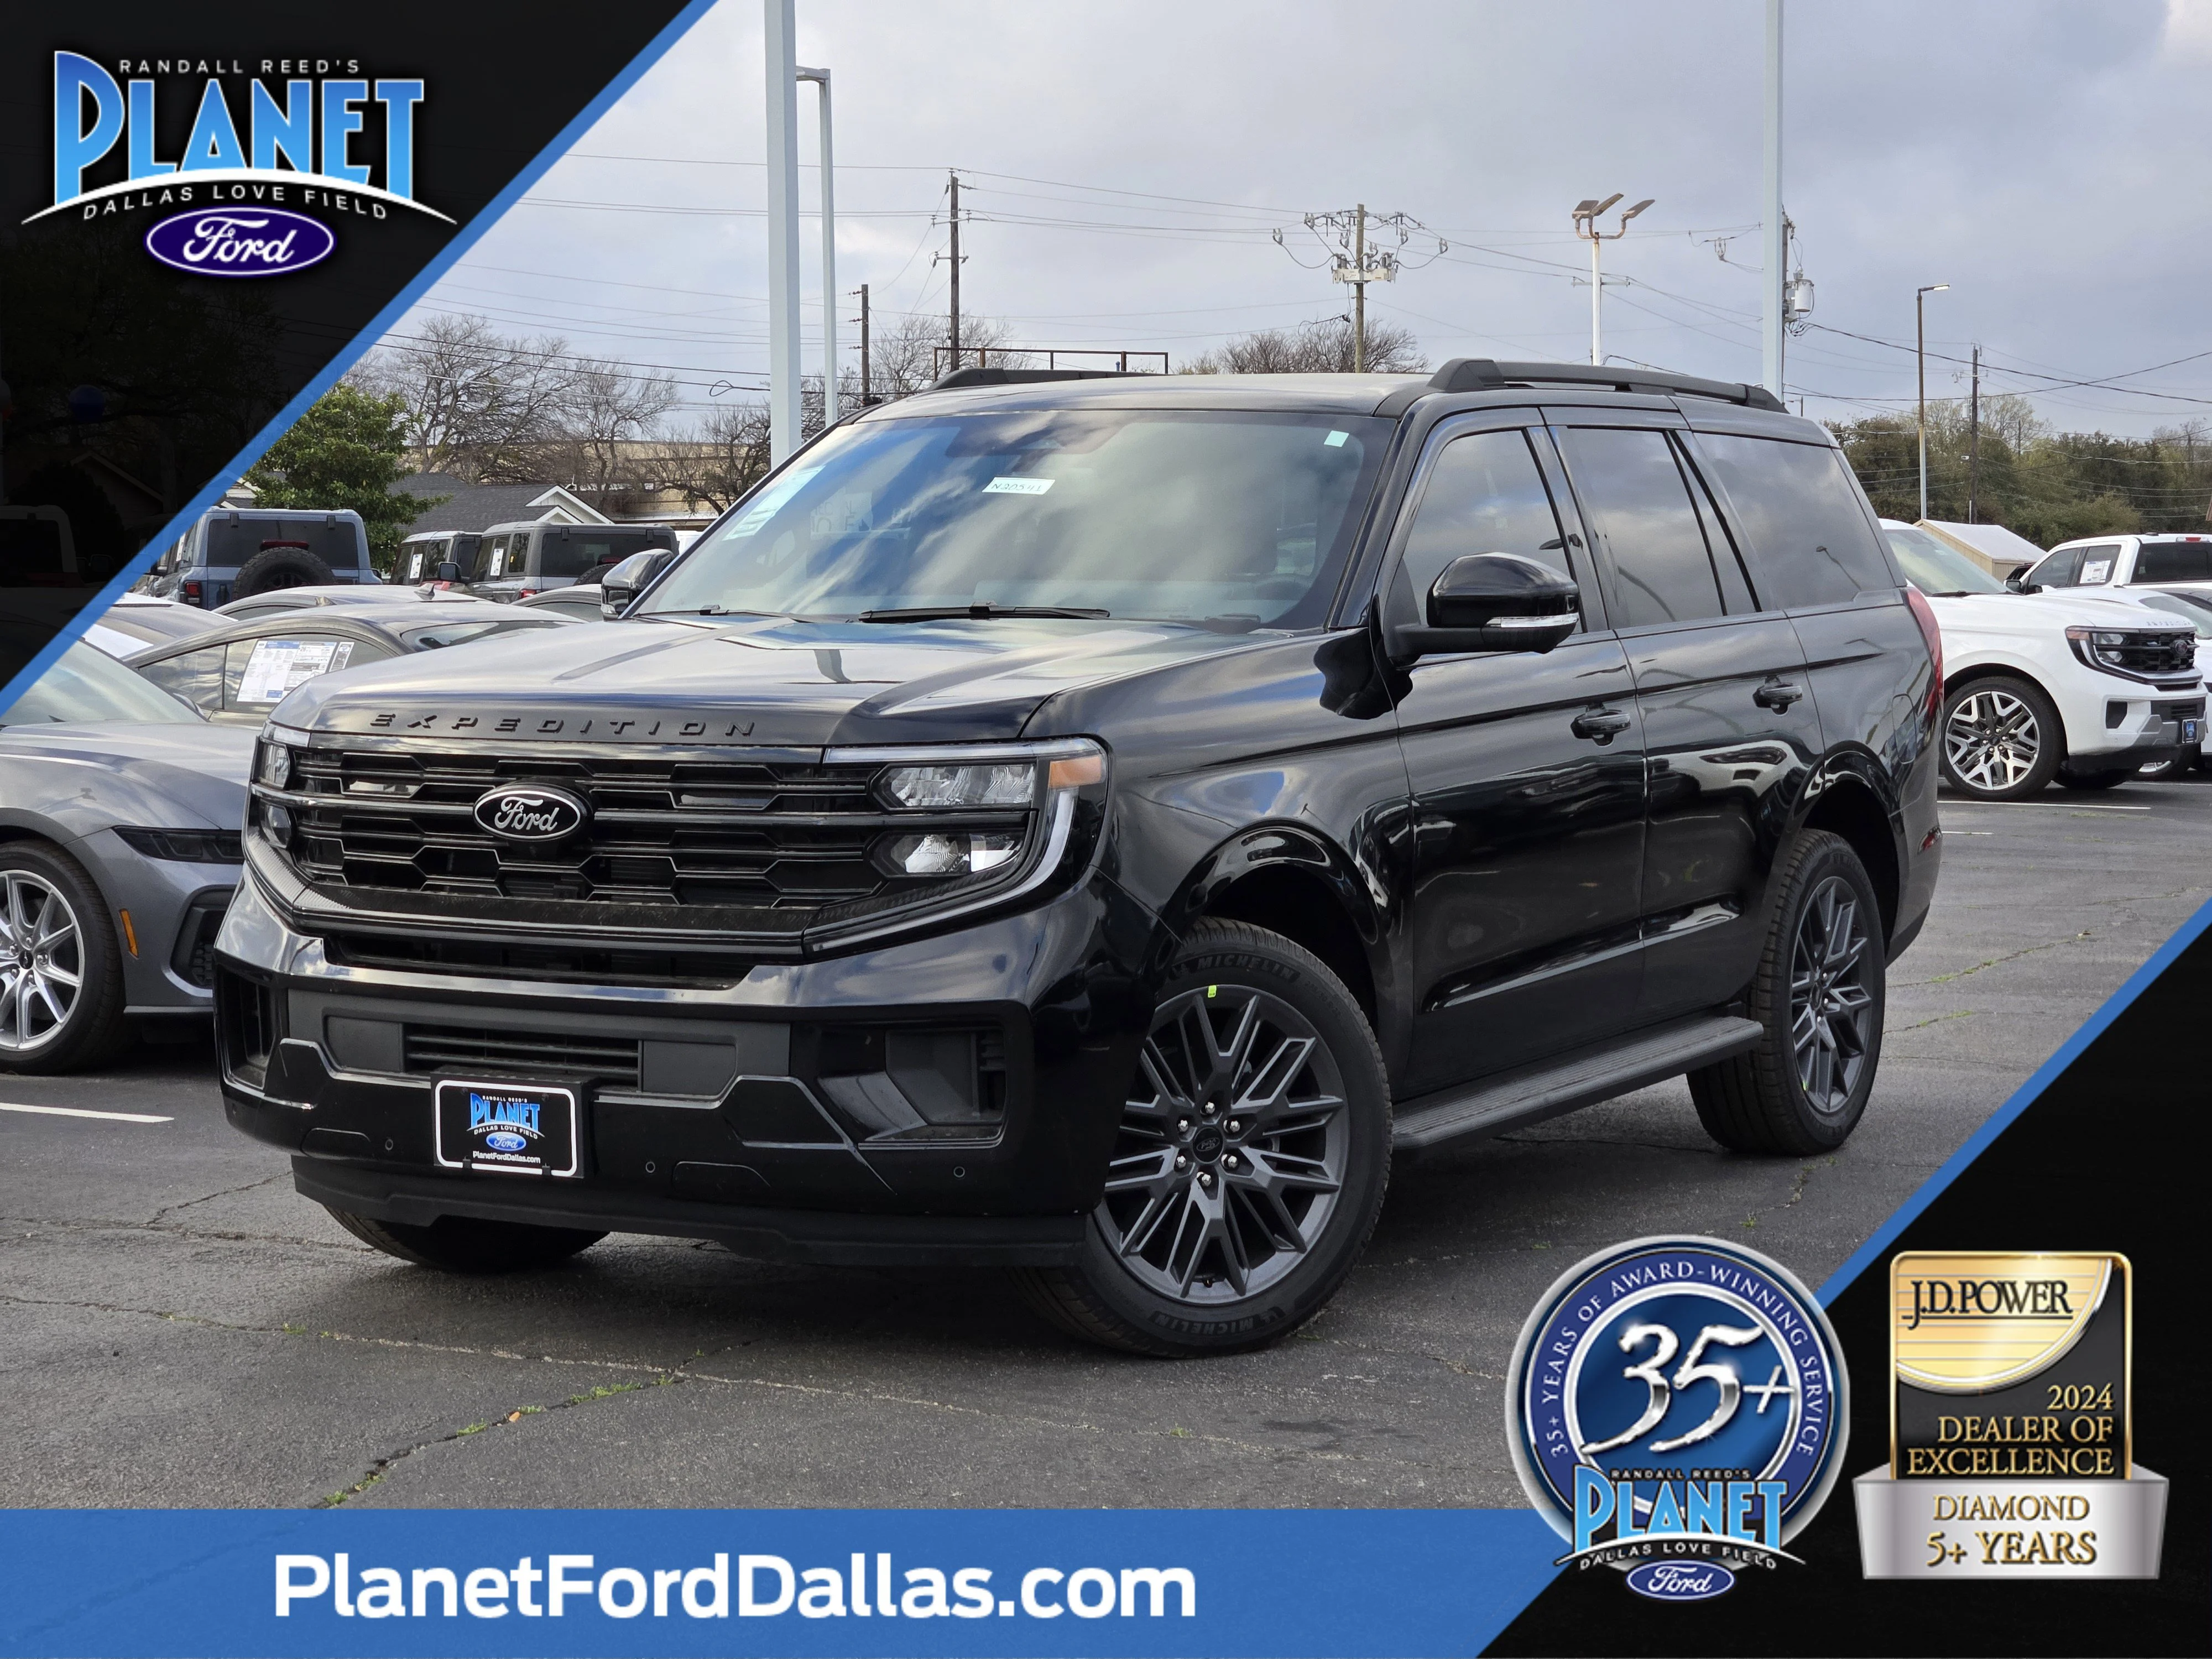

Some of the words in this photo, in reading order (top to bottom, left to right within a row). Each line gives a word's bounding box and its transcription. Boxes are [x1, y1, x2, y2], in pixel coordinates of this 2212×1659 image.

[369, 712, 757, 737] EXPEDITION
[494, 796, 560, 832] Ford
[1198, 953, 1295, 979] MICHELIN
[471, 1093, 540, 1131] PLANET
[474, 1125, 498, 1135] DALLAS
[519, 1128, 538, 1139] FIELD
[494, 1135, 518, 1149] Ford
[473, 1151, 541, 1164] PlanetFordDallas.com
